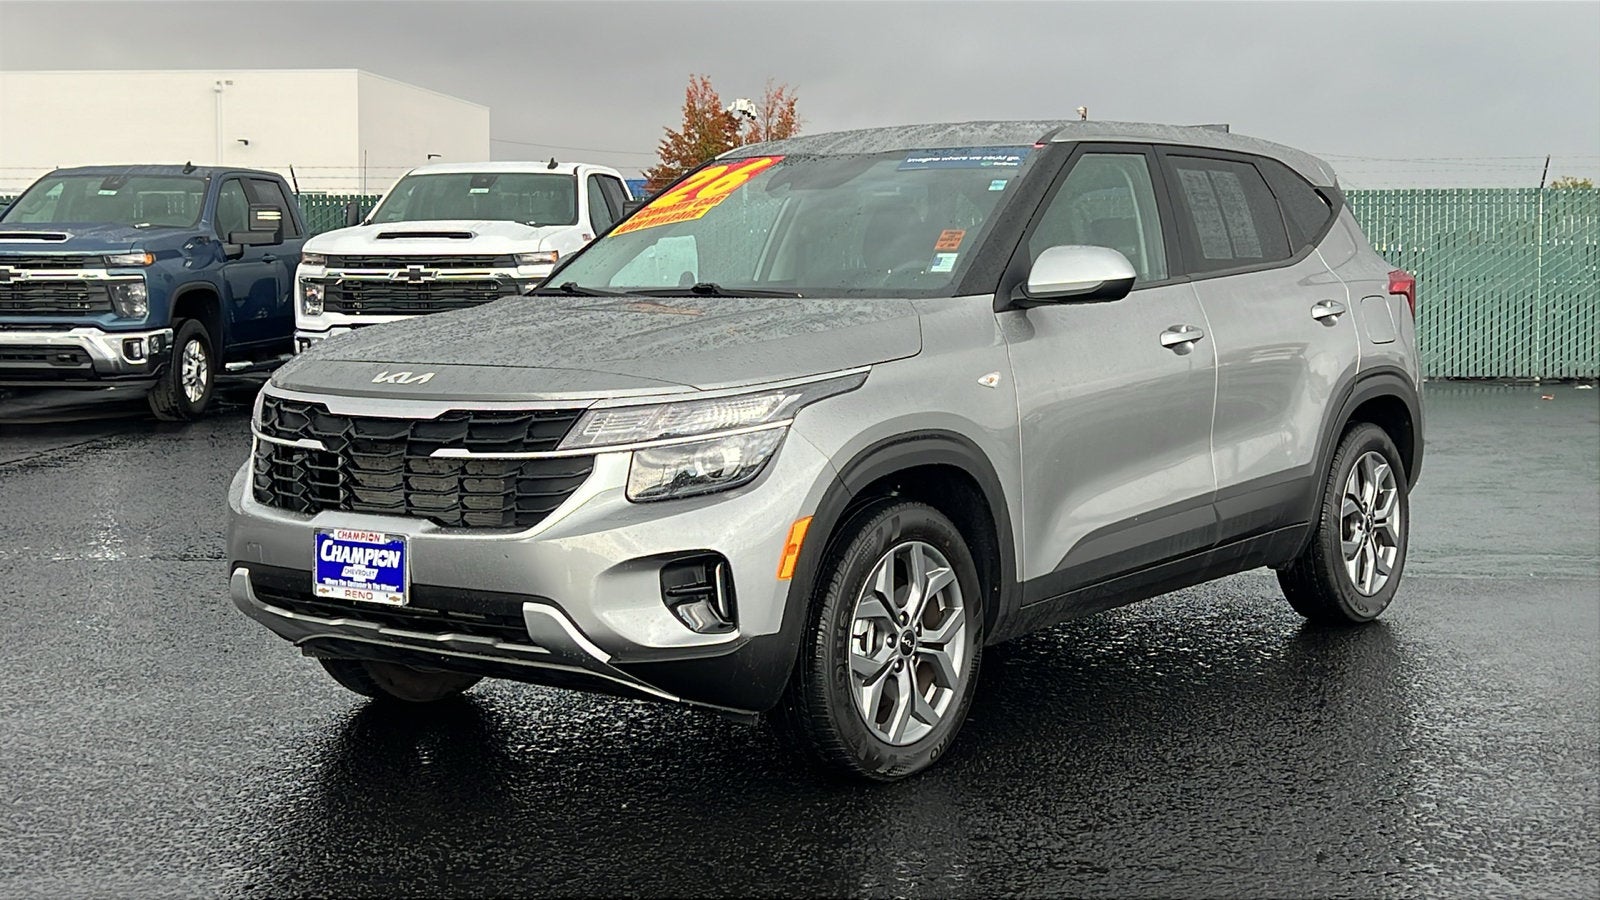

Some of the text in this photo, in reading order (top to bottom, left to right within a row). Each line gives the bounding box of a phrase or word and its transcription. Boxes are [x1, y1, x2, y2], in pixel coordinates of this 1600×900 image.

[648, 158, 772, 208] 26
[371, 370, 435, 384] KIA
[337, 530, 381, 542] CHAMPION
[320, 539, 401, 569] CHAMPION
[344, 567, 375, 577] CHEVROLET
[345, 589, 374, 600] RENO
